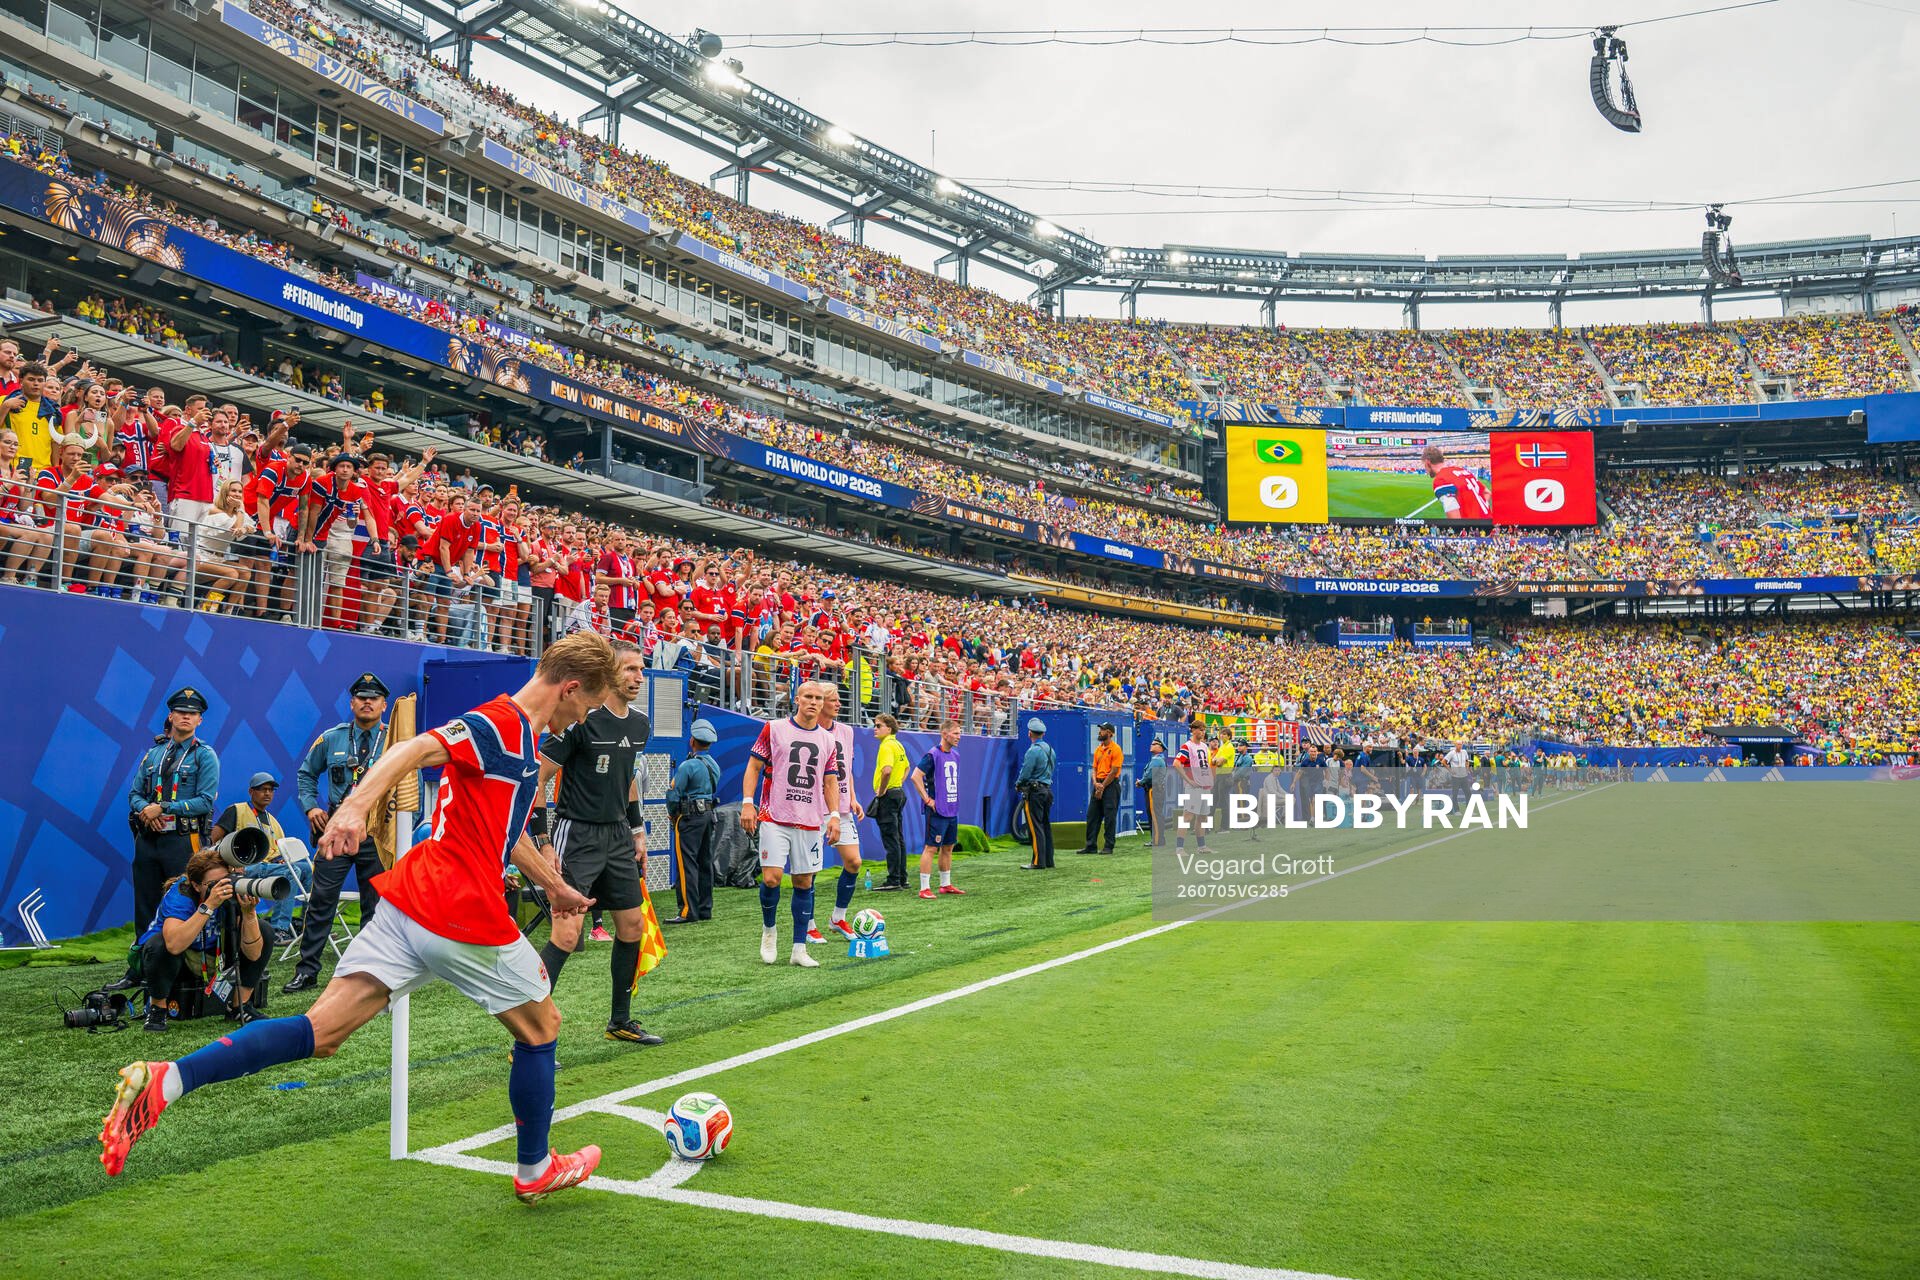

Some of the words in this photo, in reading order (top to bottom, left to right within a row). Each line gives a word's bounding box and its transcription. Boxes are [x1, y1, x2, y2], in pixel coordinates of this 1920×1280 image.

[718, 252, 770, 285] #FIFAWorldCup
[282, 282, 364, 330] #FIFAWorldCup
[551, 381, 578, 402] NEW
[580, 392, 612, 414] YORK
[614, 402, 640, 422] NEW
[642, 412, 683, 436] JERSEY
[1090, 395, 1106, 406] NEW
[1108, 400, 1127, 412] YORK
[1128, 406, 1144, 416] NEW
[1144, 411, 1170, 424] JERSEY
[1370, 411, 1442, 426] #FIFAWorldCup
[31, 422, 38, 435] 9
[766, 450, 790, 472] FIFA
[790, 458, 828, 482] WORLD
[828, 470, 848, 488] CUP
[849, 476, 882, 498] 2026
[946, 504, 964, 518] NEW
[964, 510, 982, 524] YORK
[983, 514, 998, 528] NEW
[999, 519, 1025, 534] JERSEY
[1315, 581, 1338, 591] FIFA
[1339, 582, 1378, 592] WORLD
[1379, 582, 1400, 592] CUP
[1401, 583, 1440, 593] 2026
[1518, 584, 1538, 593] NEW
[1540, 584, 1566, 593] YORK
[1568, 584, 1588, 593] NEW
[1590, 584, 1626, 593] JERSEY
[1754, 582, 1802, 590] #FIFAWorldCup
[786, 794, 812, 803] 2026
[810, 842, 820, 859] 4
